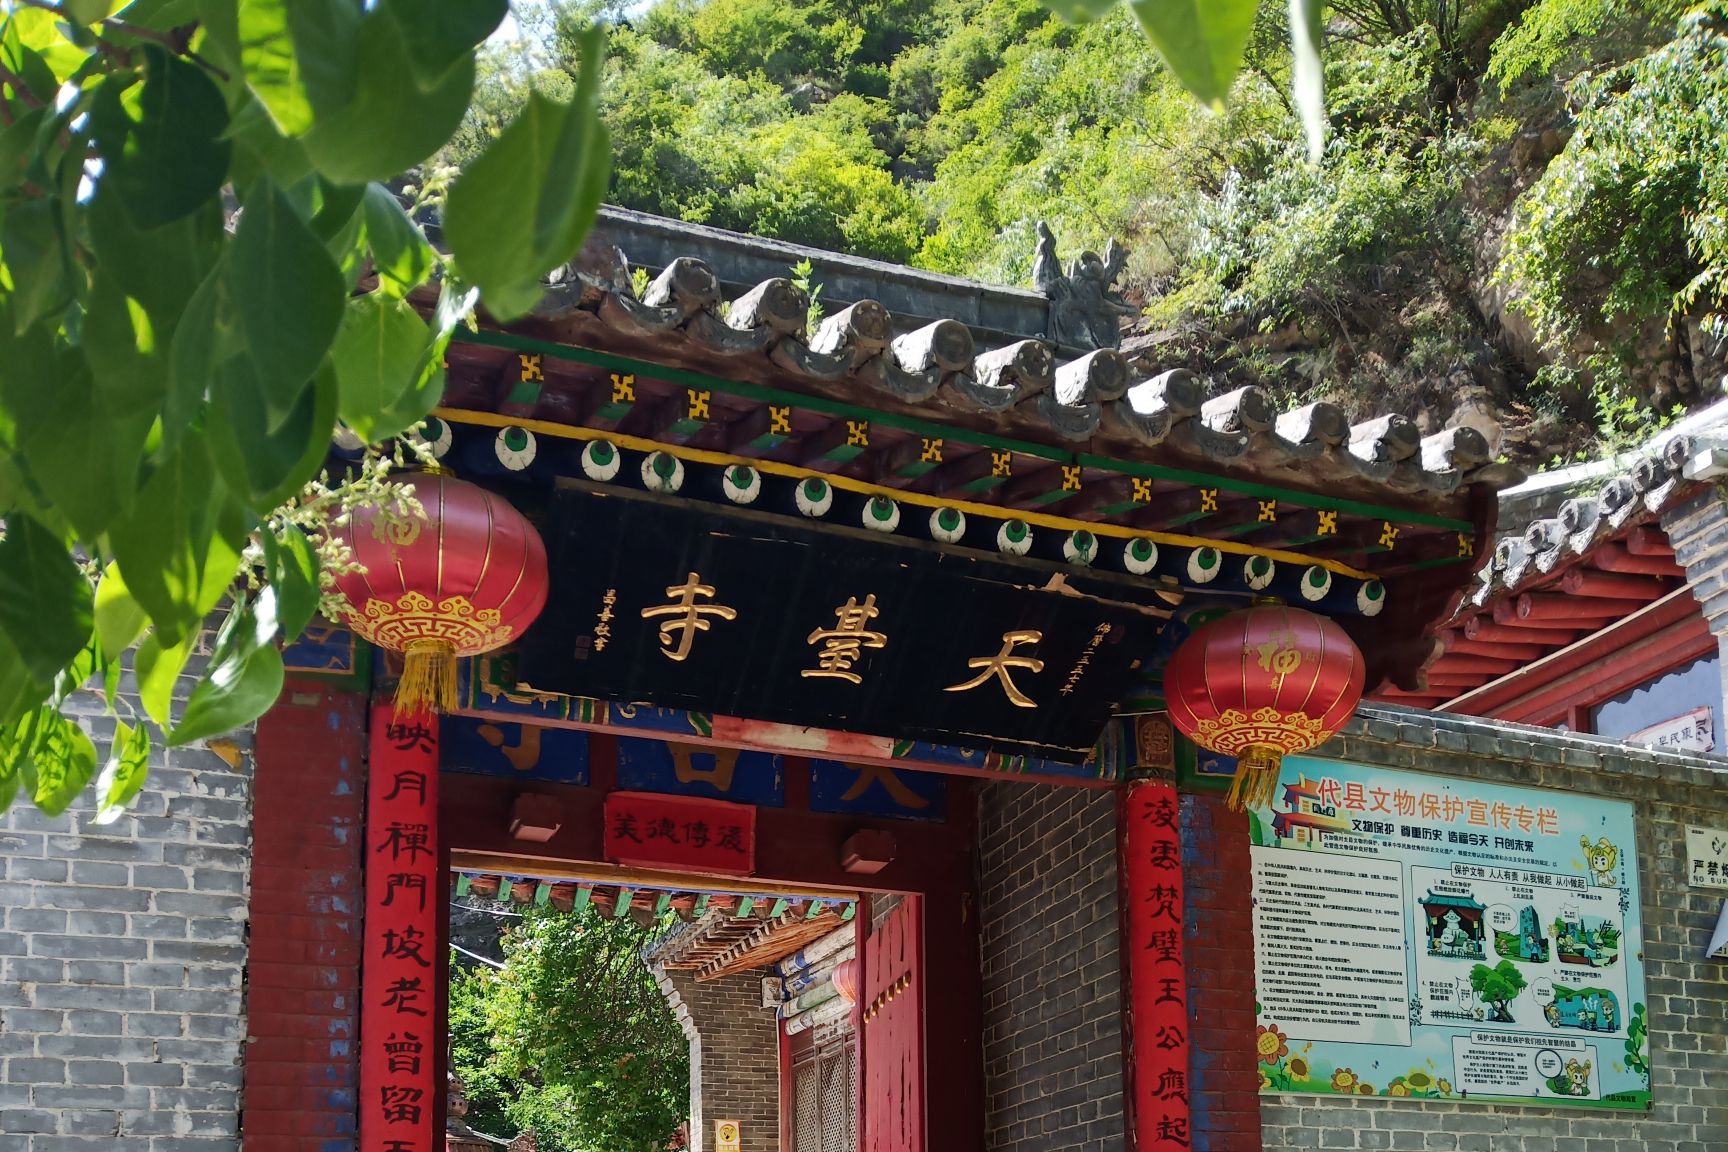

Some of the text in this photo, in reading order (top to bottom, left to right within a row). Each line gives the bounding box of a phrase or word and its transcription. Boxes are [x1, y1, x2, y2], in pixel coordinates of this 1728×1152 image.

[1256, 642, 1302, 675] 福
[1316, 777, 1560, 835] 代县文物保护宣传专栏
[1351, 819, 1535, 853] 文物保护 尊重历史 造福今天 开创未来
[1454, 865, 1585, 889] 保护文物 人人有责 从我做起 从小做起
[1693, 875, 1704, 883] NO
[1476, 1033, 1577, 1048] 保护文物就是保护我们祖先智慧的结晶
